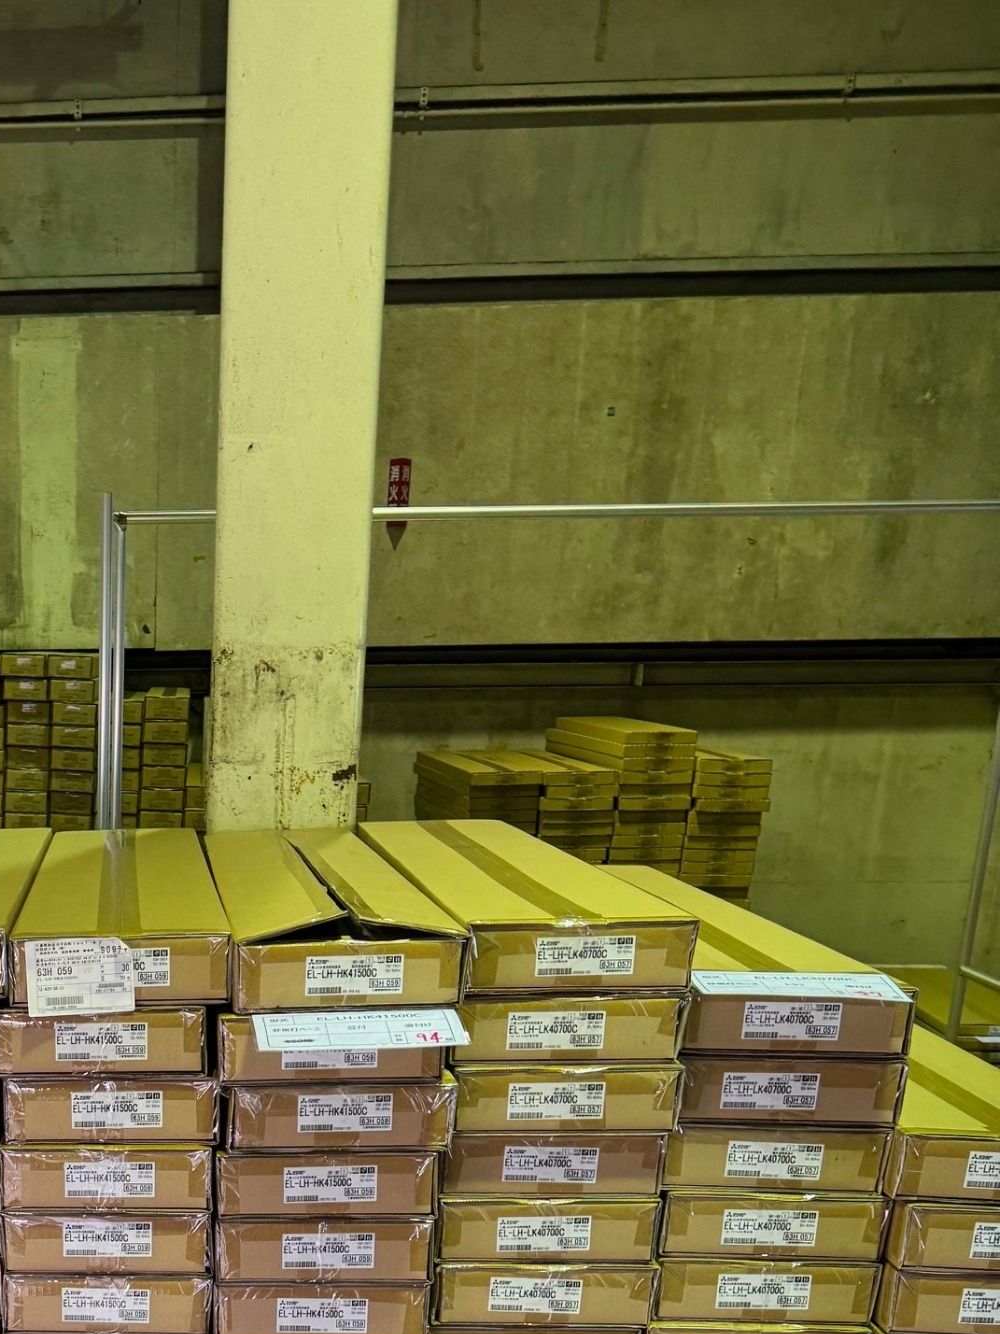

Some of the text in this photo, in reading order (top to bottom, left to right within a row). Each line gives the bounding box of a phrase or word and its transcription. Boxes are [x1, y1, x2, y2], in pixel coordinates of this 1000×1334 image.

[389, 465, 400, 506] 消火
[400, 465, 410, 506] 消火
[537, 949, 608, 960] EL-LH-LK40700C
[37, 967, 72, 976] 63H 059
[306, 967, 378, 979] EL-LH-HK41500C
[744, 1014, 814, 1024] EL-LH-LK40700C
[508, 1024, 578, 1035] EL-LH-LK40700C
[56, 1035, 124, 1045] EL-LH-HK41500C
[723, 1084, 792, 1095] EL-LH-LK40700C
[509, 1094, 578, 1105] EL-LH-LK40700C
[299, 1106, 368, 1117] EL-LH-HK41500C
[504, 1158, 572, 1168] EL-LH-LK40700C
[728, 1153, 796, 1164] EL-LH-LK40700C
[65, 1173, 131, 1183] EL-LH-HK41500C
[284, 1177, 353, 1188] EL-LH-HK41500C
[724, 1221, 792, 1231] EL-LH-LK40700C
[64, 1233, 129, 1242] EL-LH-HK41500C
[498, 1227, 565, 1238] EL-LH-LK40700C
[490, 1288, 556, 1299] EL-LH-LK40700C
[718, 1285, 785, 1295] EL-LH-LK40700C
